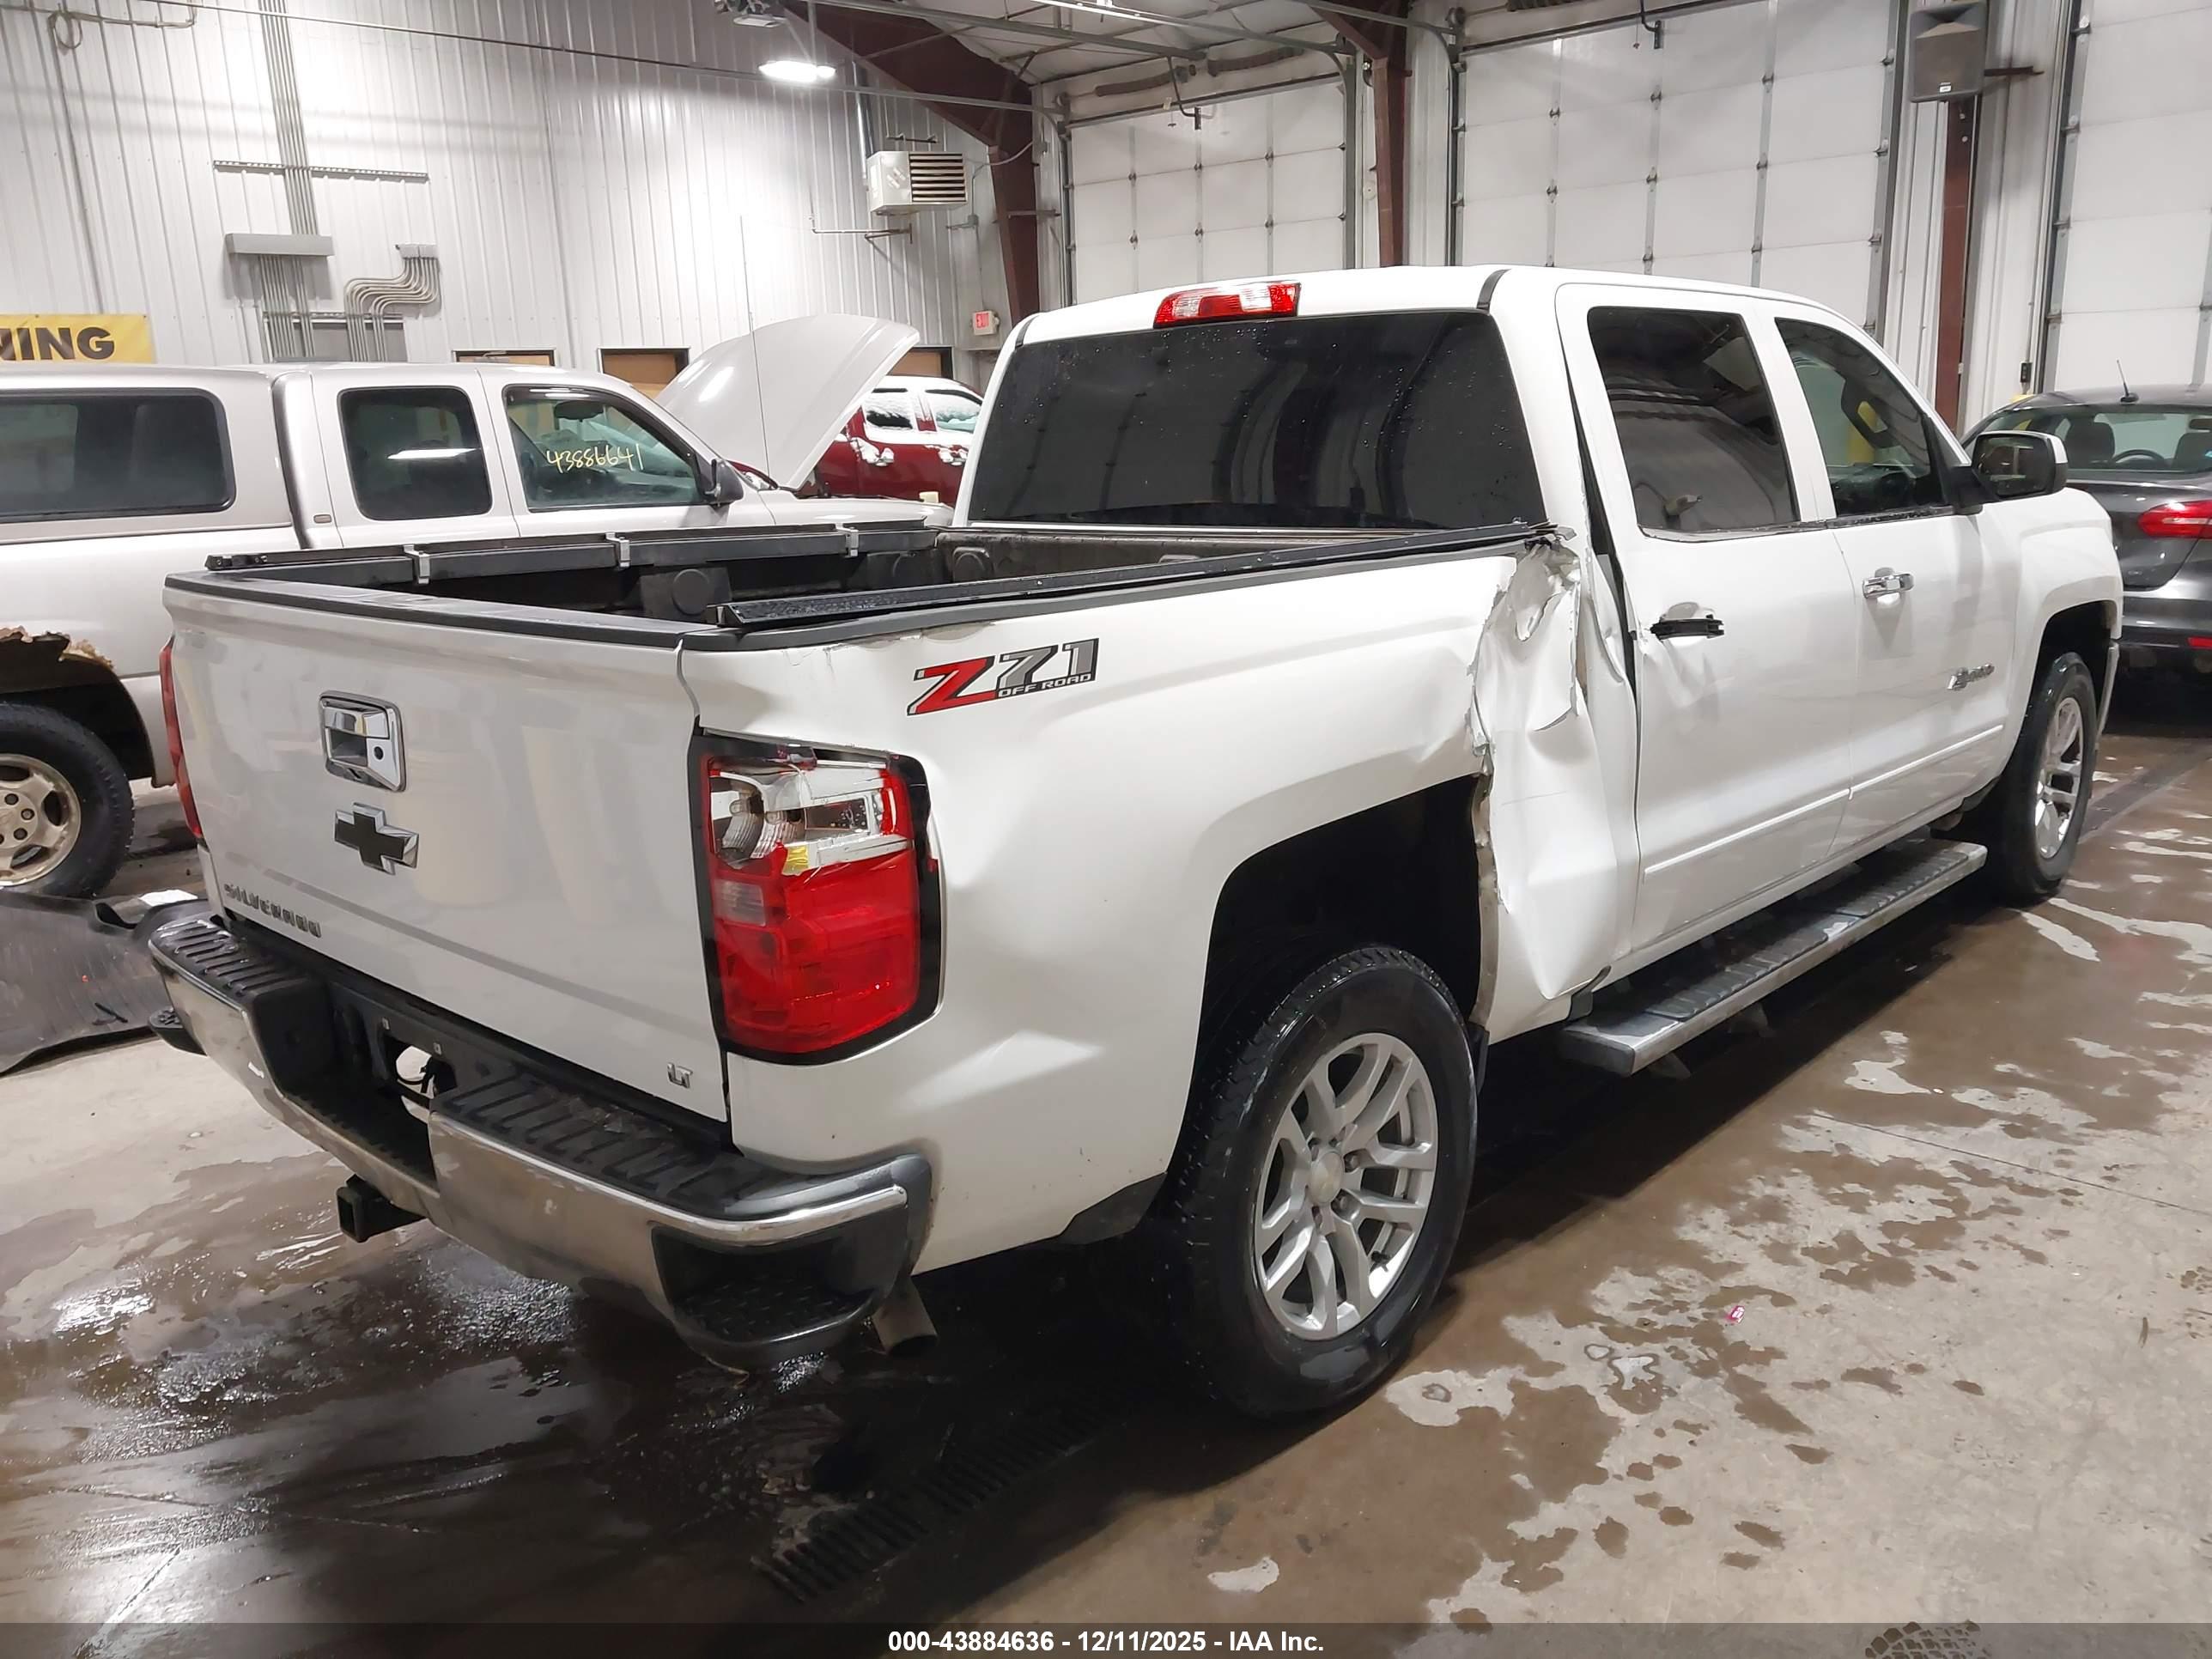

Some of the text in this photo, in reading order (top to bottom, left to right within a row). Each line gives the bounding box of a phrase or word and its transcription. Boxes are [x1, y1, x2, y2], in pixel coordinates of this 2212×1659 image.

[546, 442, 645, 474] 43886641
[907, 638, 1100, 716] Z71
[998, 673, 1092, 698] OFF ROAD
[667, 1061, 694, 1089] LT
